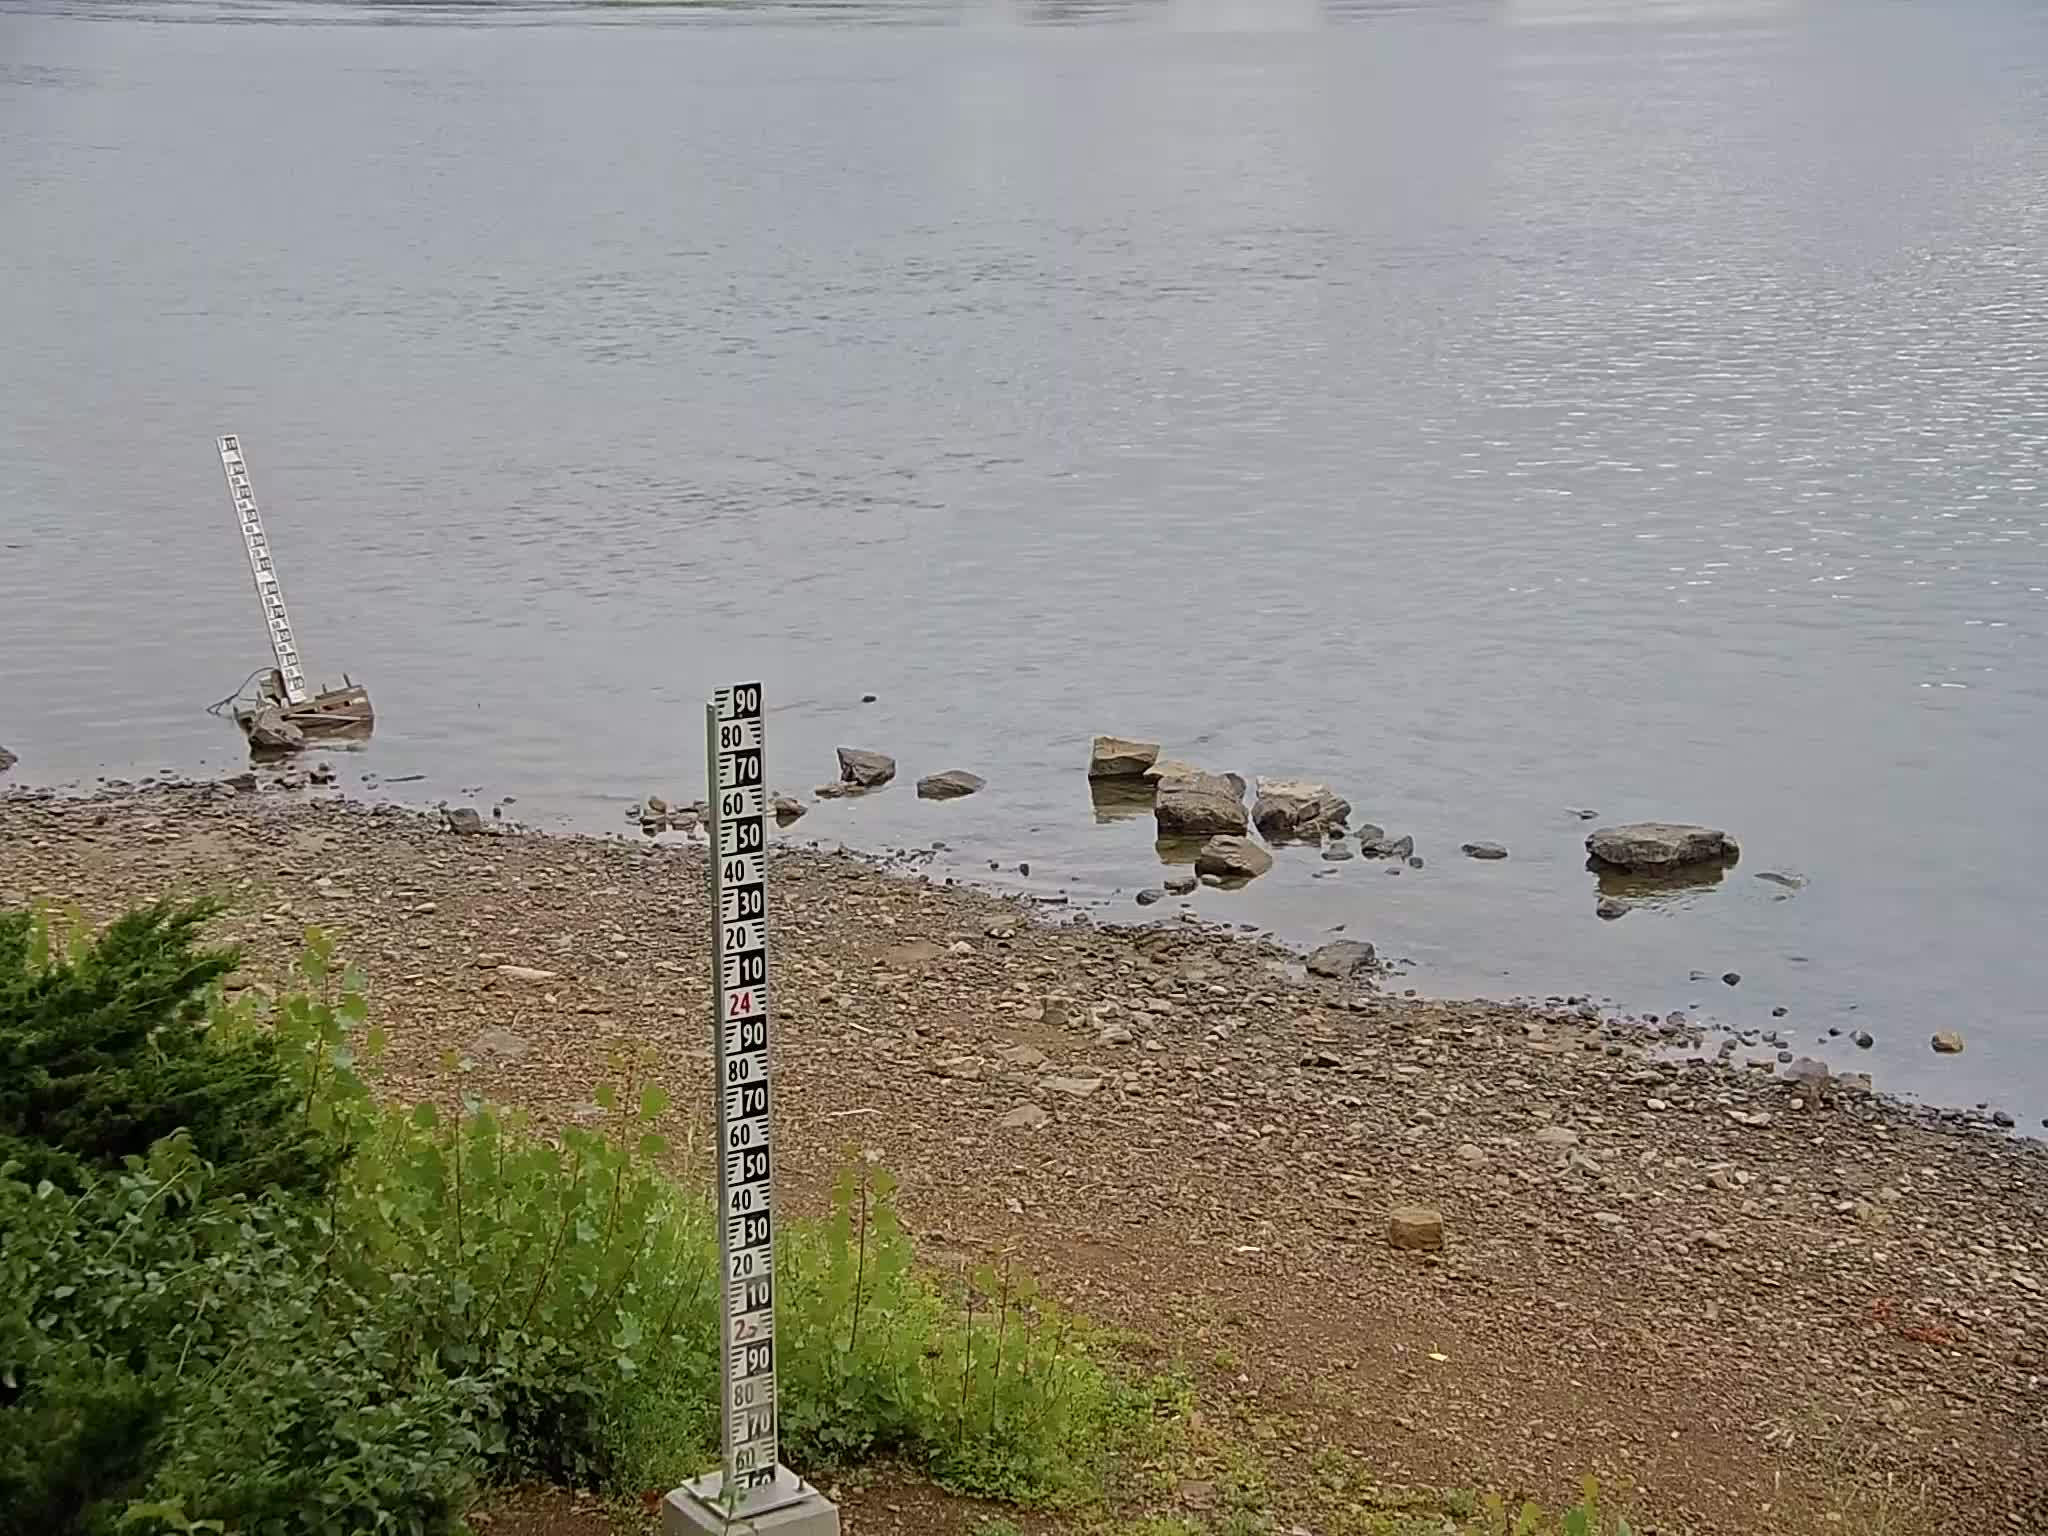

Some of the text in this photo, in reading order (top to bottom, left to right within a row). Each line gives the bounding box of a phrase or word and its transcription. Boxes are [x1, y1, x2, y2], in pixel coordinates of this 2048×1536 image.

[736, 688, 756, 713] 90
[721, 725, 741, 748] 80
[737, 756, 758, 780] 70
[723, 792, 742, 816] 60
[740, 824, 759, 848] 50
[724, 860, 744, 883] 40
[741, 890, 760, 915] 30
[726, 926, 745, 950] 20
[743, 956, 762, 980] 10
[730, 992, 750, 1016] 24
[743, 1022, 763, 1046] 90
[729, 1059, 748, 1082] 80
[744, 1088, 764, 1112] 70
[730, 1124, 750, 1147] 60
[746, 1153, 766, 1177] 50
[731, 1188, 751, 1211] 40
[747, 1217, 767, 1240] 30
[733, 1253, 752, 1278] 20
[749, 1282, 768, 1306] 10
[749, 1347, 769, 1371] 90
[734, 1383, 752, 1406] 80
[750, 1413, 769, 1437] 70
[736, 1448, 754, 1472] 60
